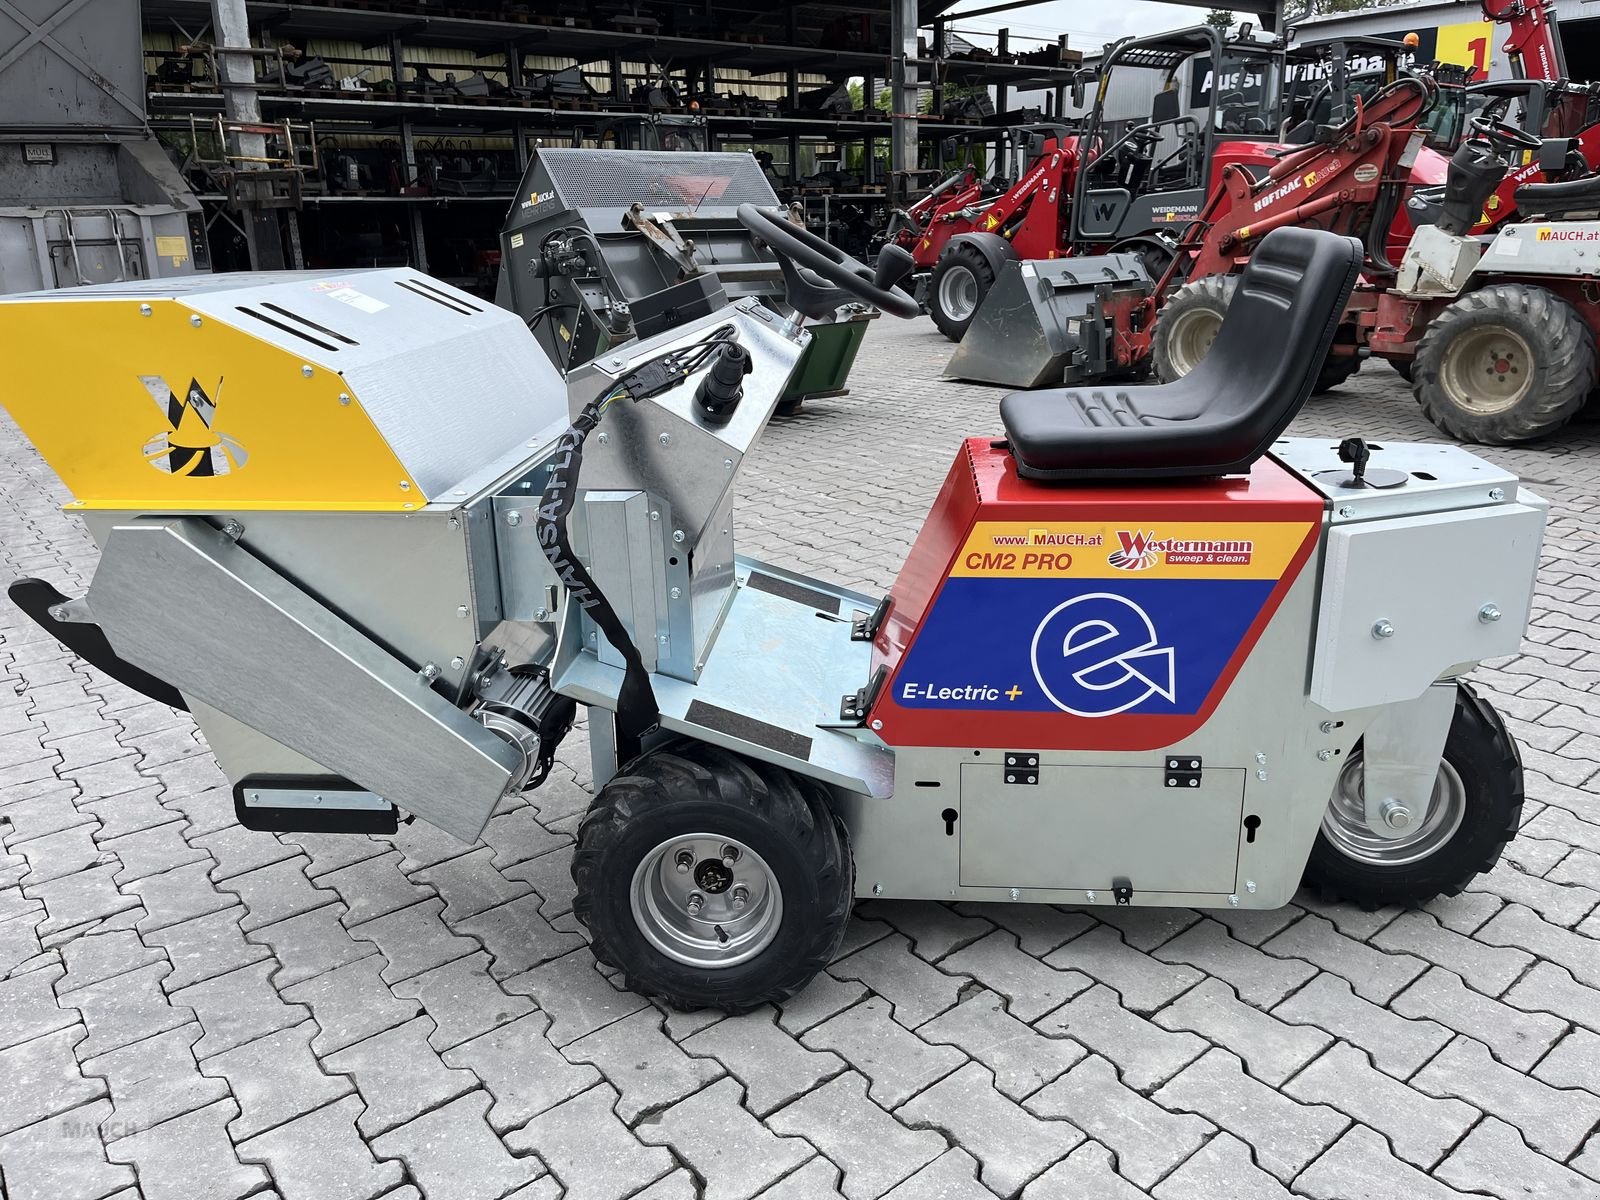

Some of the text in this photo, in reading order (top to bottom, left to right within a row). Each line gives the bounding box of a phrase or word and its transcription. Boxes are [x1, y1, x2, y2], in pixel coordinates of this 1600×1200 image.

[1467, 37, 1489, 82] 1
[1013, 167, 1046, 200] WEIDEMANN
[1253, 176, 1302, 213] HOFTRAC
[1151, 205, 1198, 214] WEIDEMANN
[1540, 230, 1600, 241] MAUCH.at
[1117, 531, 1253, 556] Westermann
[965, 552, 1073, 571] CM2 PRO
[1168, 553, 1248, 564] sweep & clean.
[902, 683, 999, 701] E-Lectric
